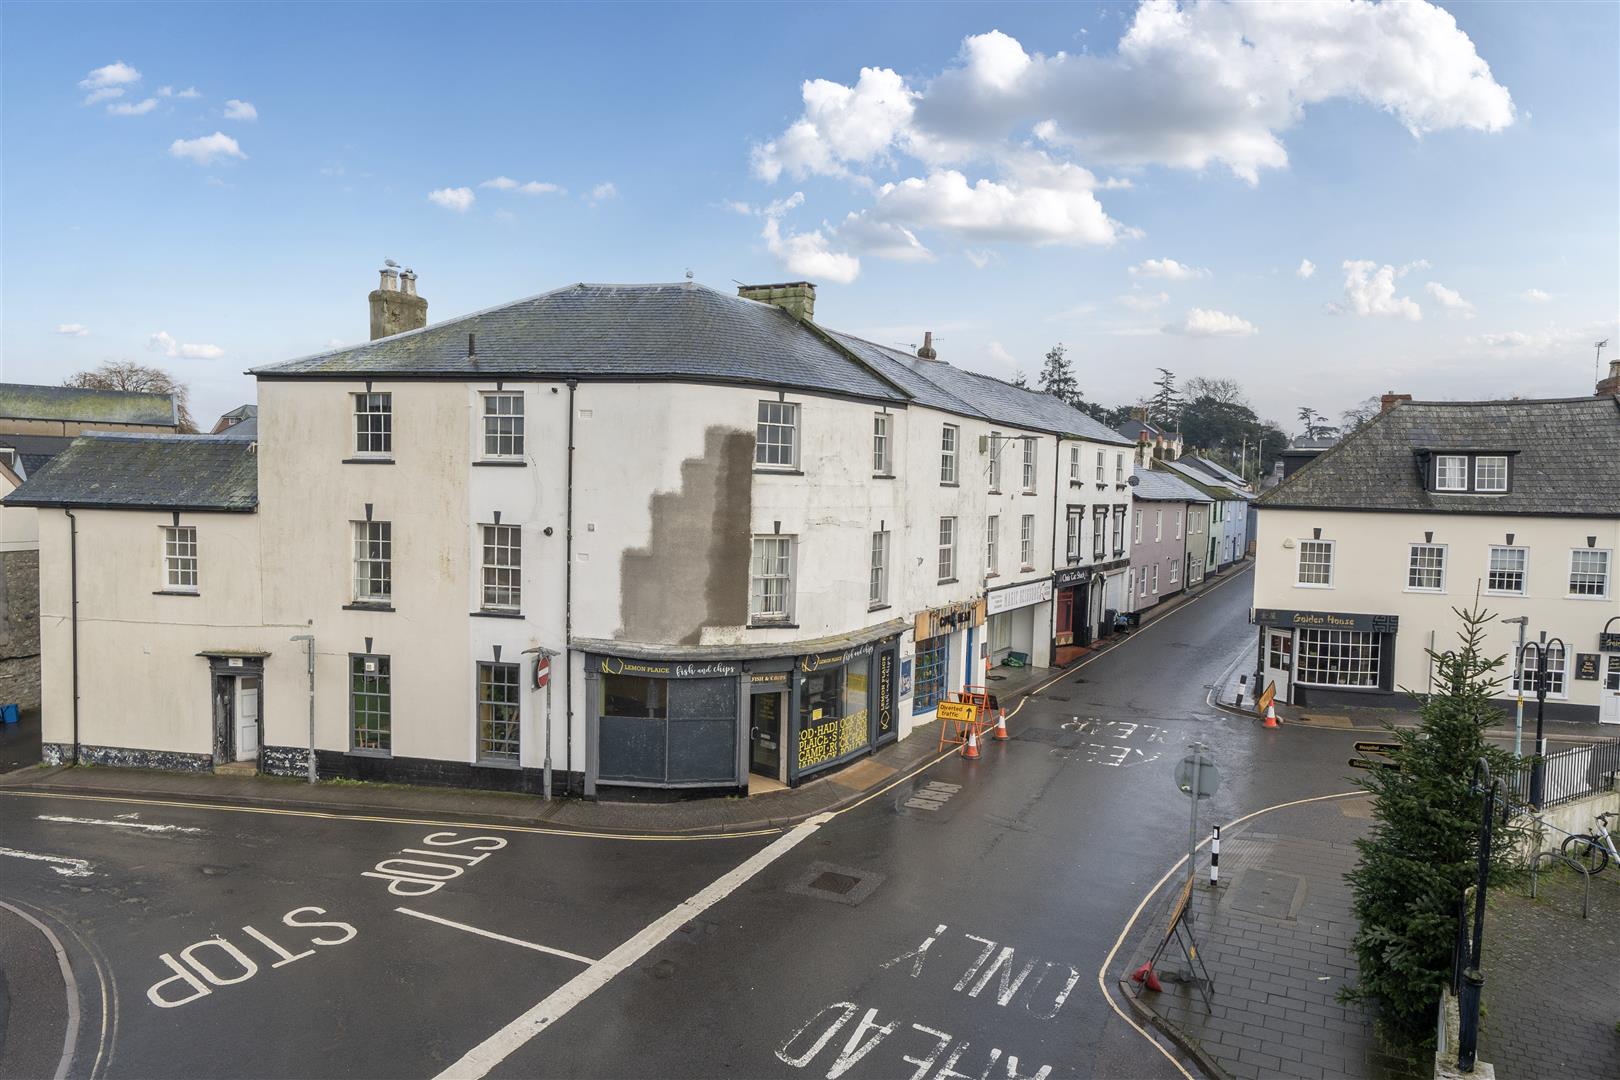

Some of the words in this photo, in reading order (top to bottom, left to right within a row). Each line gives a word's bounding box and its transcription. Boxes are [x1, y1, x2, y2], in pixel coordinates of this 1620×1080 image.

[1293, 612, 1324, 622] Golden
[1328, 615, 1355, 625] House
[676, 664, 696, 677] fish
[696, 666, 712, 674] and
[713, 662, 736, 676] chips
[799, 728, 814, 740] OD
[361, 832, 508, 897] STOP
[146, 906, 358, 1009] STOP
[880, 924, 1080, 1020] ONLY
